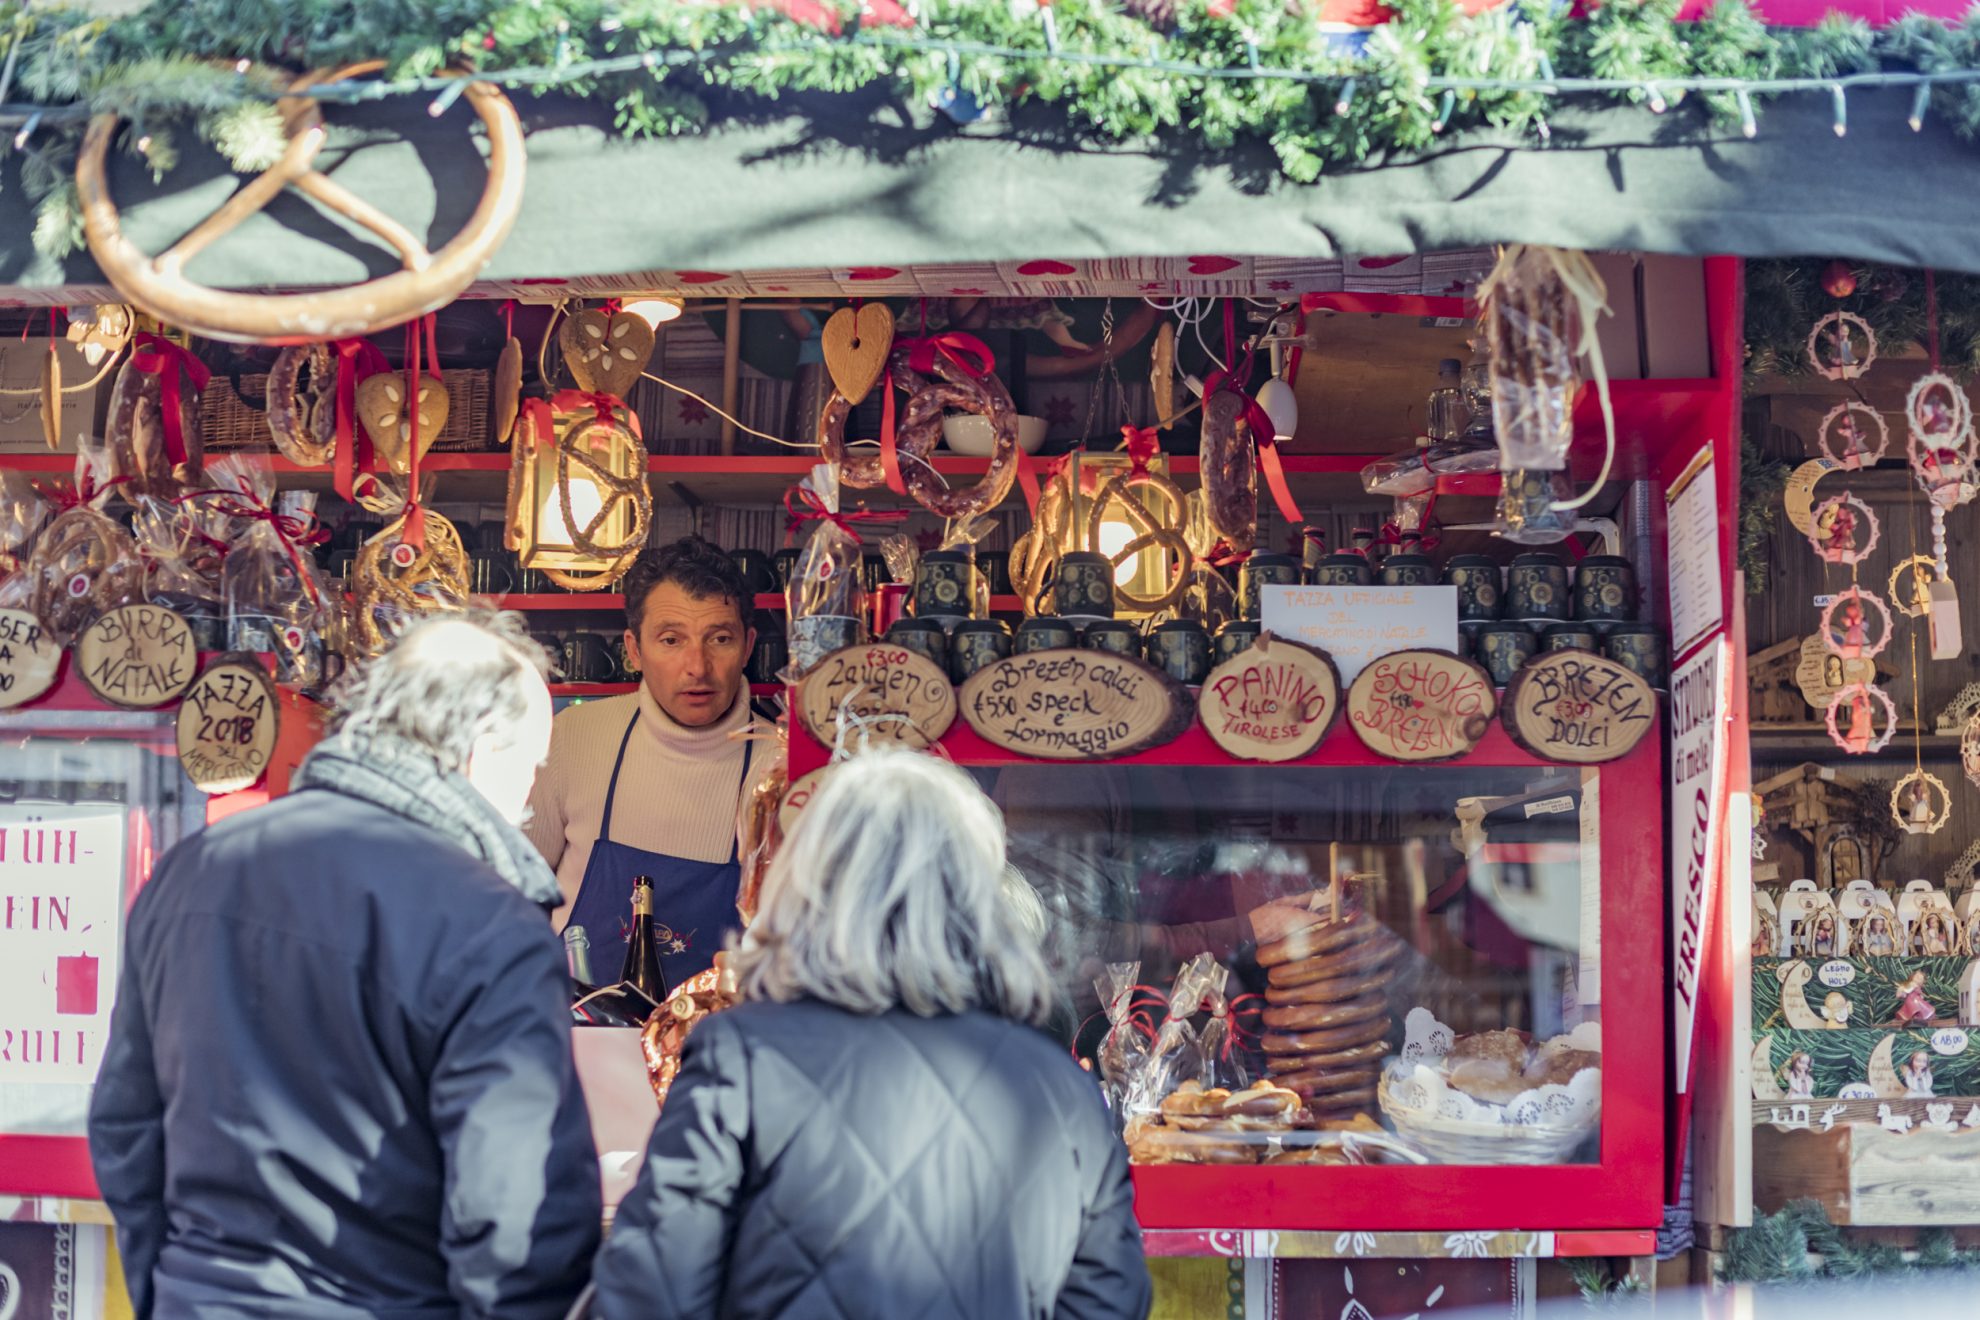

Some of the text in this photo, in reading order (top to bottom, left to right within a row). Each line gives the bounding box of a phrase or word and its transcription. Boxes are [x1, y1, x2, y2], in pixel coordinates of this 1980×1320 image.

[1283, 590, 1335, 608] TAZZA
[91, 657, 186, 698] NATALE
[187, 674, 265, 719] TAZZA
[1373, 662, 1485, 716] SCHOKO
[1531, 660, 1650, 723] BREZEN
[196, 715, 256, 745] 2018
[1222, 712, 1302, 740] TIROLESE
[1354, 694, 1459, 753] BREZEN
[1677, 787, 1709, 1012] FRESCO
